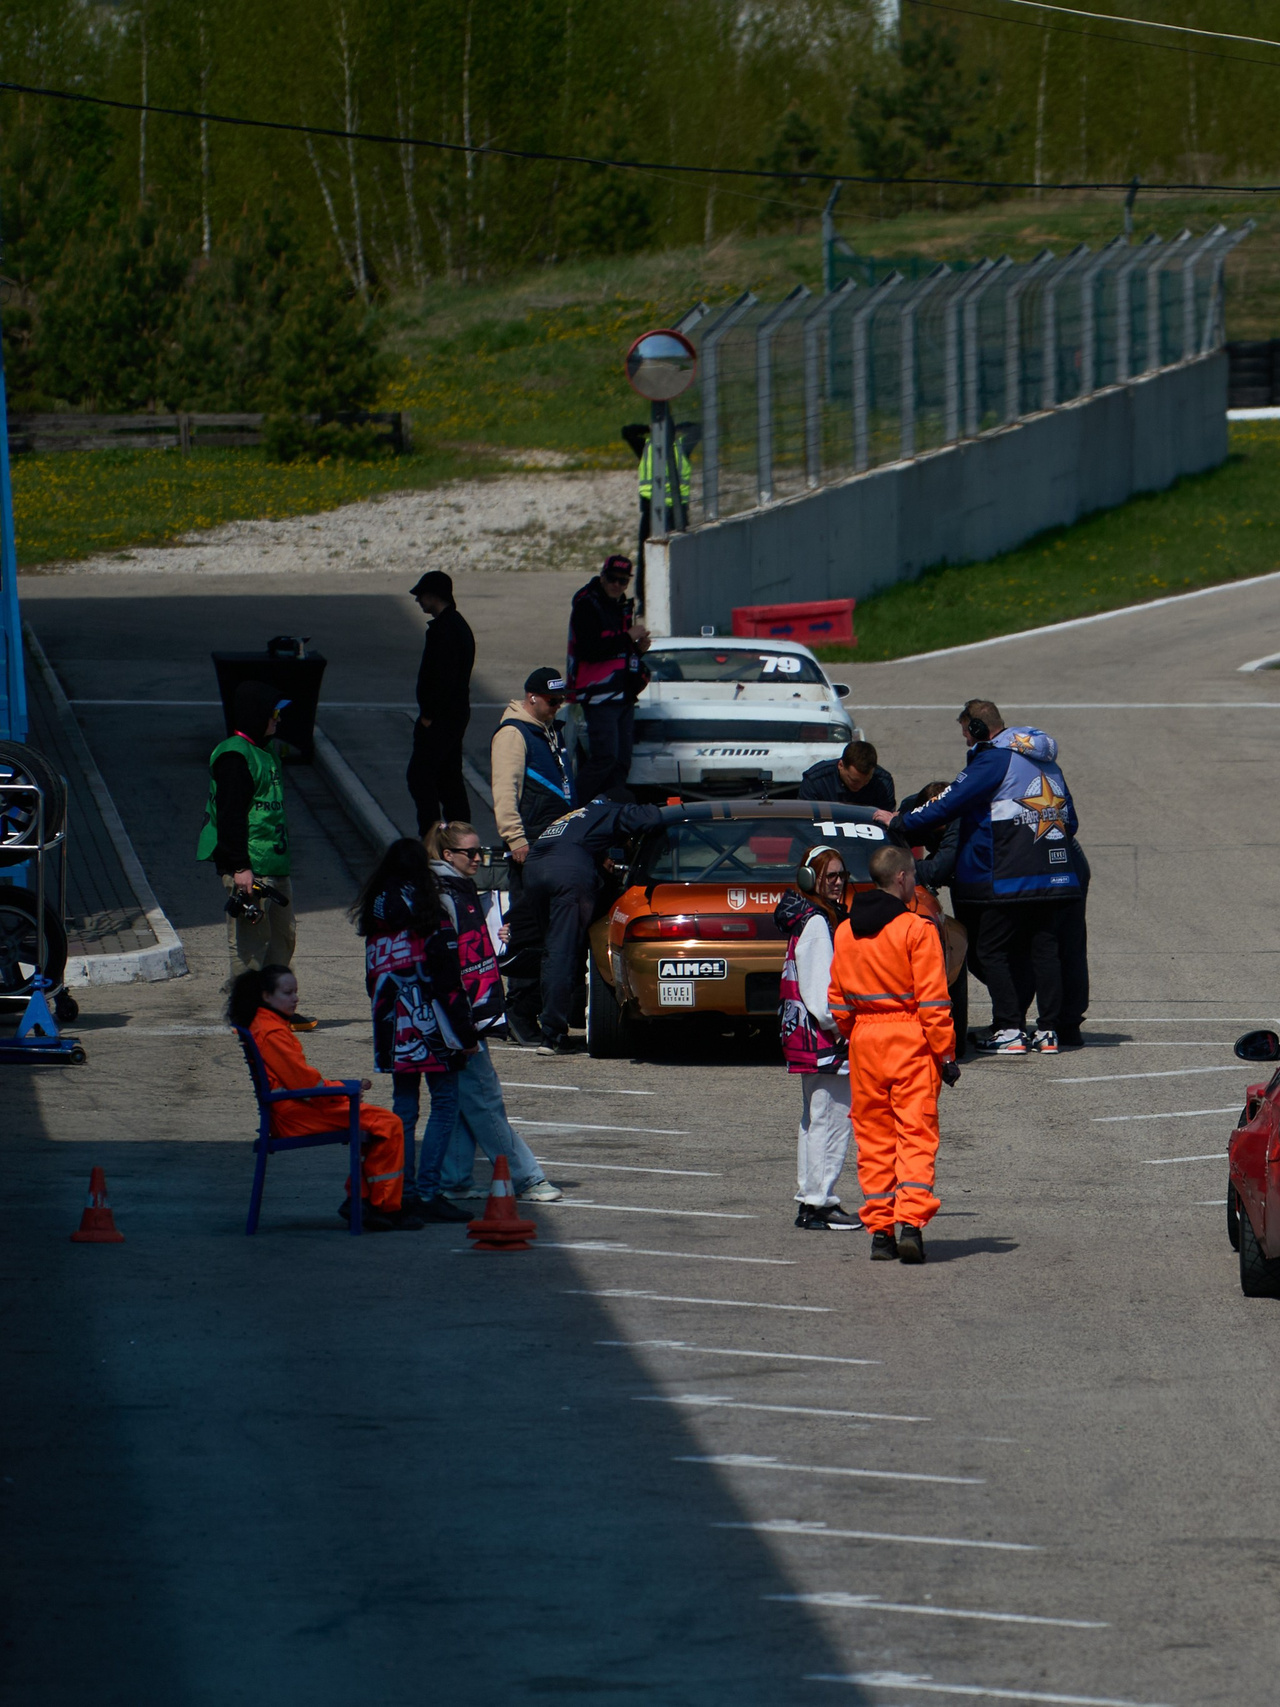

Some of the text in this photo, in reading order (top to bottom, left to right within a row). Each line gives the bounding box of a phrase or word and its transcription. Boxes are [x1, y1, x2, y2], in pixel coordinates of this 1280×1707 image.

[758, 655, 801, 674] 79
[813, 821, 885, 841] 119
[749, 892, 784, 904] ЧЕМ
[661, 962, 724, 976] AIMOL
